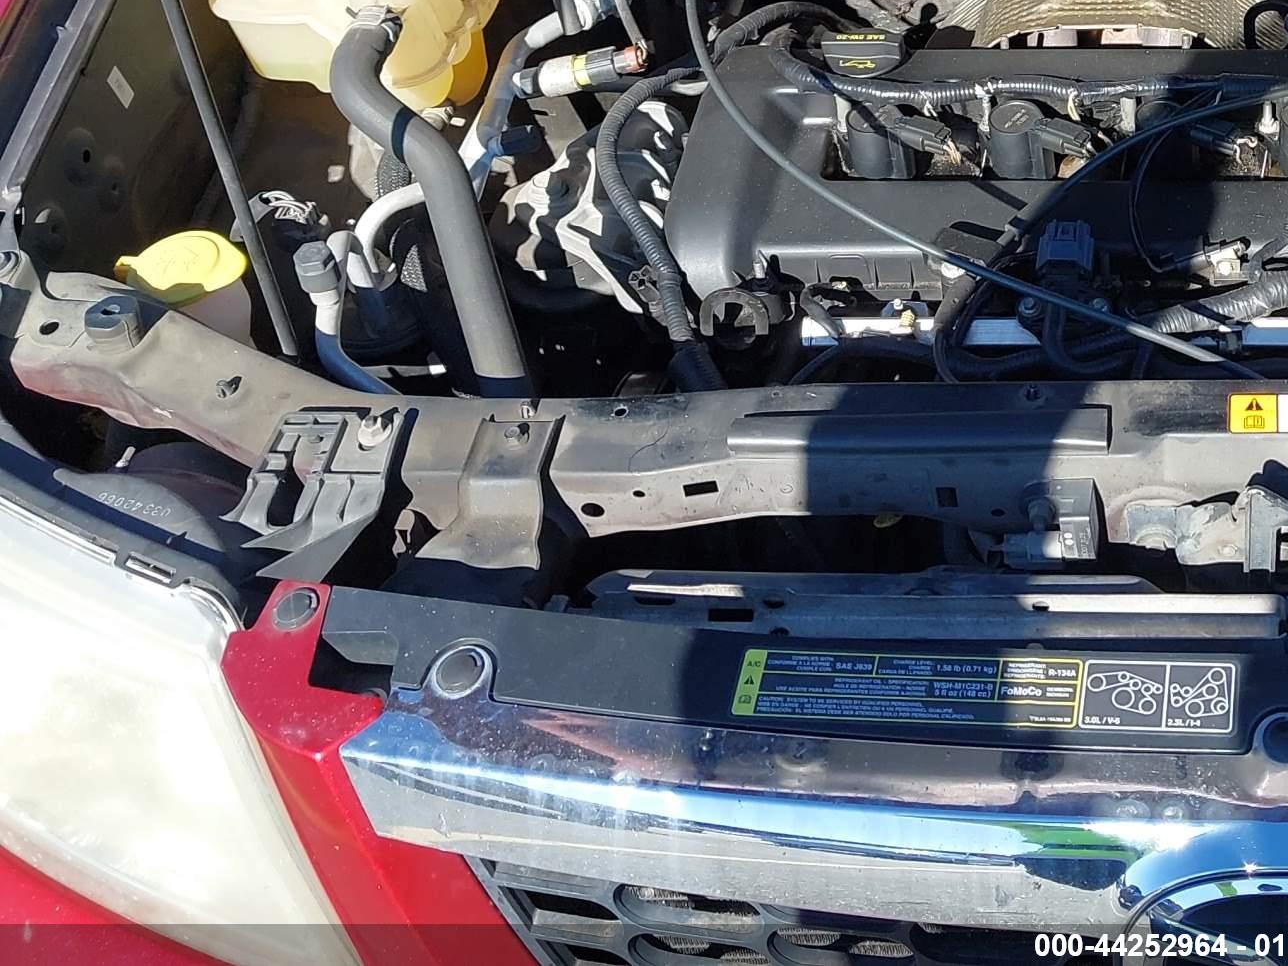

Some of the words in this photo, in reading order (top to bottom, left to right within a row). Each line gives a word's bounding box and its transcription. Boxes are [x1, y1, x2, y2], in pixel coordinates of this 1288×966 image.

[747, 660, 761, 668] A/C
[836, 662, 852, 670] SAE
[963, 665, 982, 674] (0.71
[983, 666, 997, 675] kg)
[1048, 668, 1077, 678] R-134A
[1001, 686, 1043, 697] FoMoCo
[1084, 716, 1101, 724] 3.0L
[1108, 716, 1121, 725] V-6
